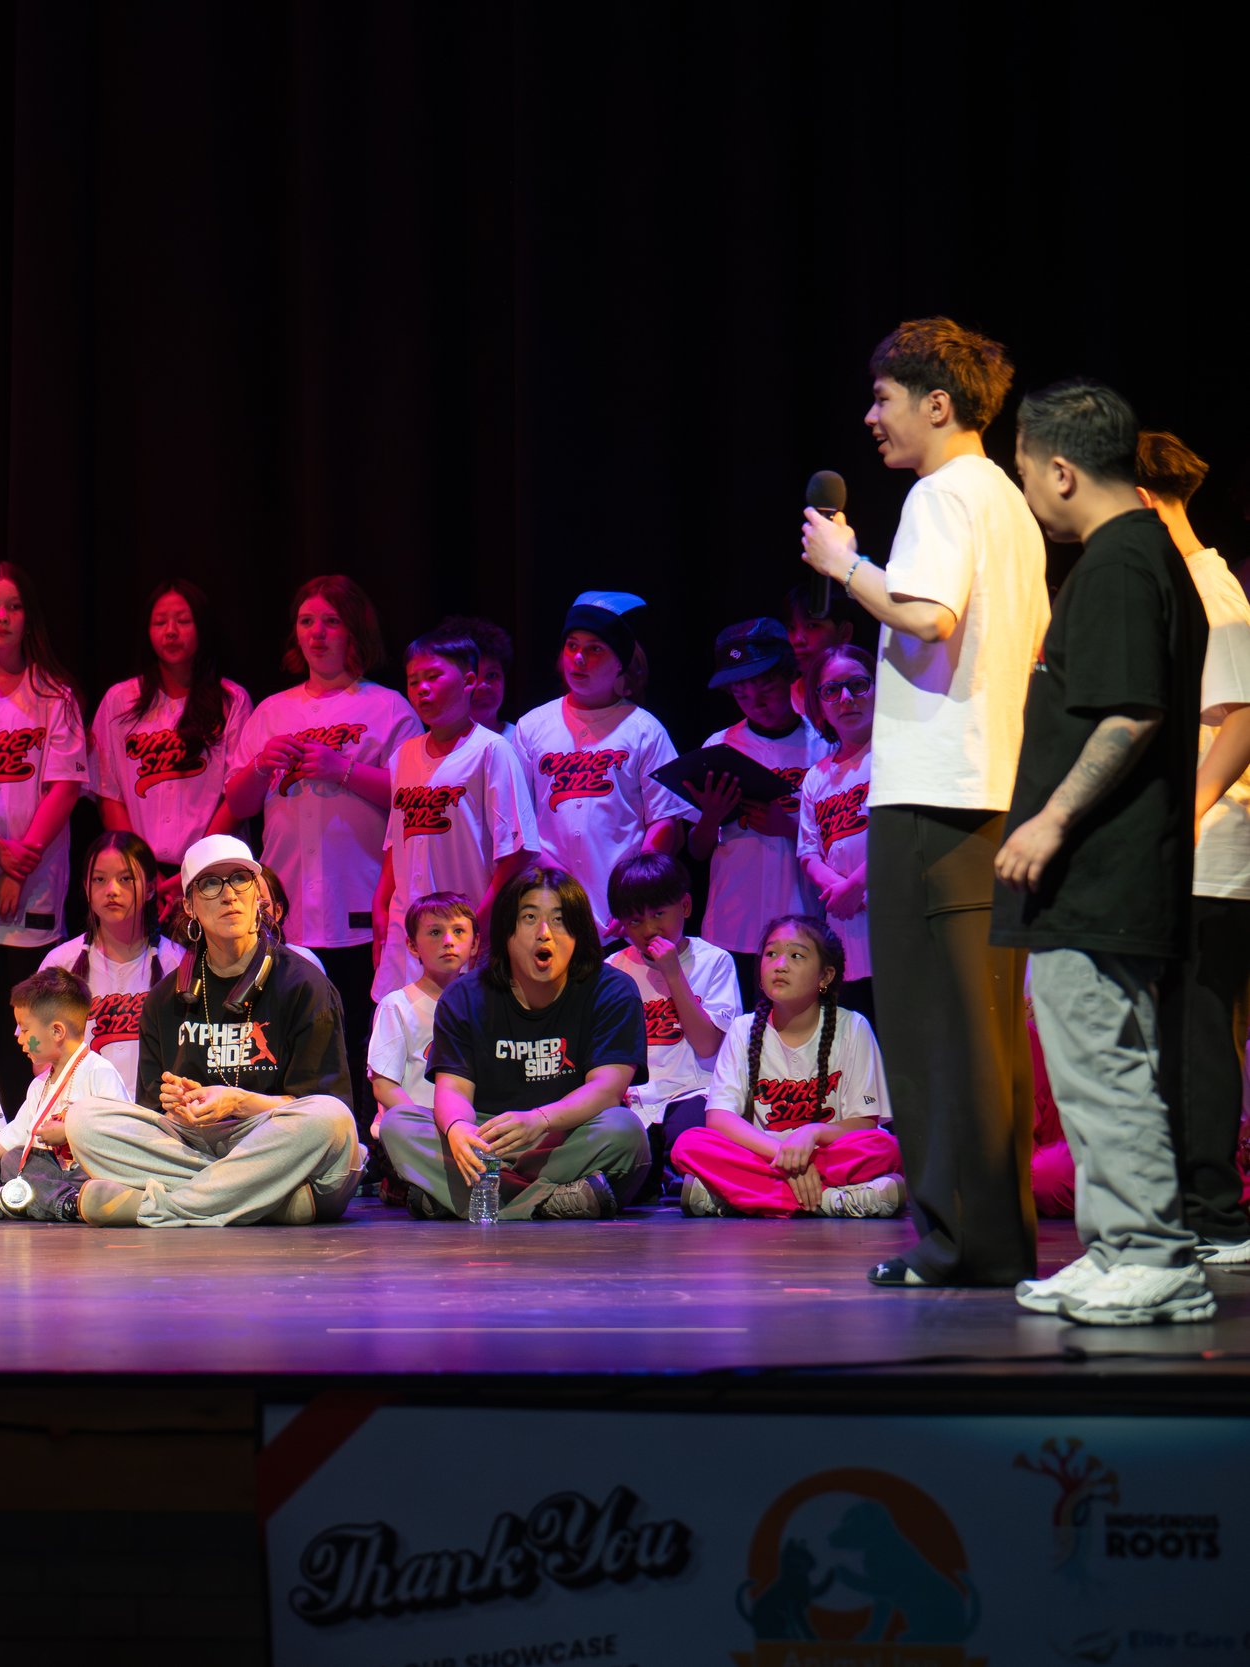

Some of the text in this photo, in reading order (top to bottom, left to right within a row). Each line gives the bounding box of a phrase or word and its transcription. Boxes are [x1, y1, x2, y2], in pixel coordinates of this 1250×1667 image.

[126, 730, 186, 760] CYPH
[294, 723, 367, 745] PHER
[137, 749, 207, 787] SID
[539, 749, 629, 774] CYPHER
[393, 786, 466, 809] CYPHER
[550, 769, 614, 800] SIDE
[815, 782, 870, 826] YPHE
[403, 806, 452, 833] SIDE
[820, 805, 870, 842] SIDE
[86, 992, 150, 1021] YPHE
[92, 1013, 140, 1043] SIDE
[178, 1021, 253, 1046] CYPHER
[646, 1017, 684, 1043] DE
[206, 1041, 254, 1068] SIDE
[495, 1037, 562, 1060] CYPHER
[207, 1063, 279, 1074] DANCE SCHOOL
[524, 1055, 562, 1077] SIDE
[525, 1074, 551, 1082] DANCE
[765, 1100, 836, 1128] SIDE
[1105, 1513, 1220, 1529] INDIGENOUS
[288, 1484, 693, 1626] Thank You
[1105, 1531, 1221, 1560] ROOTS
[466, 1633, 617, 1667] SHOWCASE
